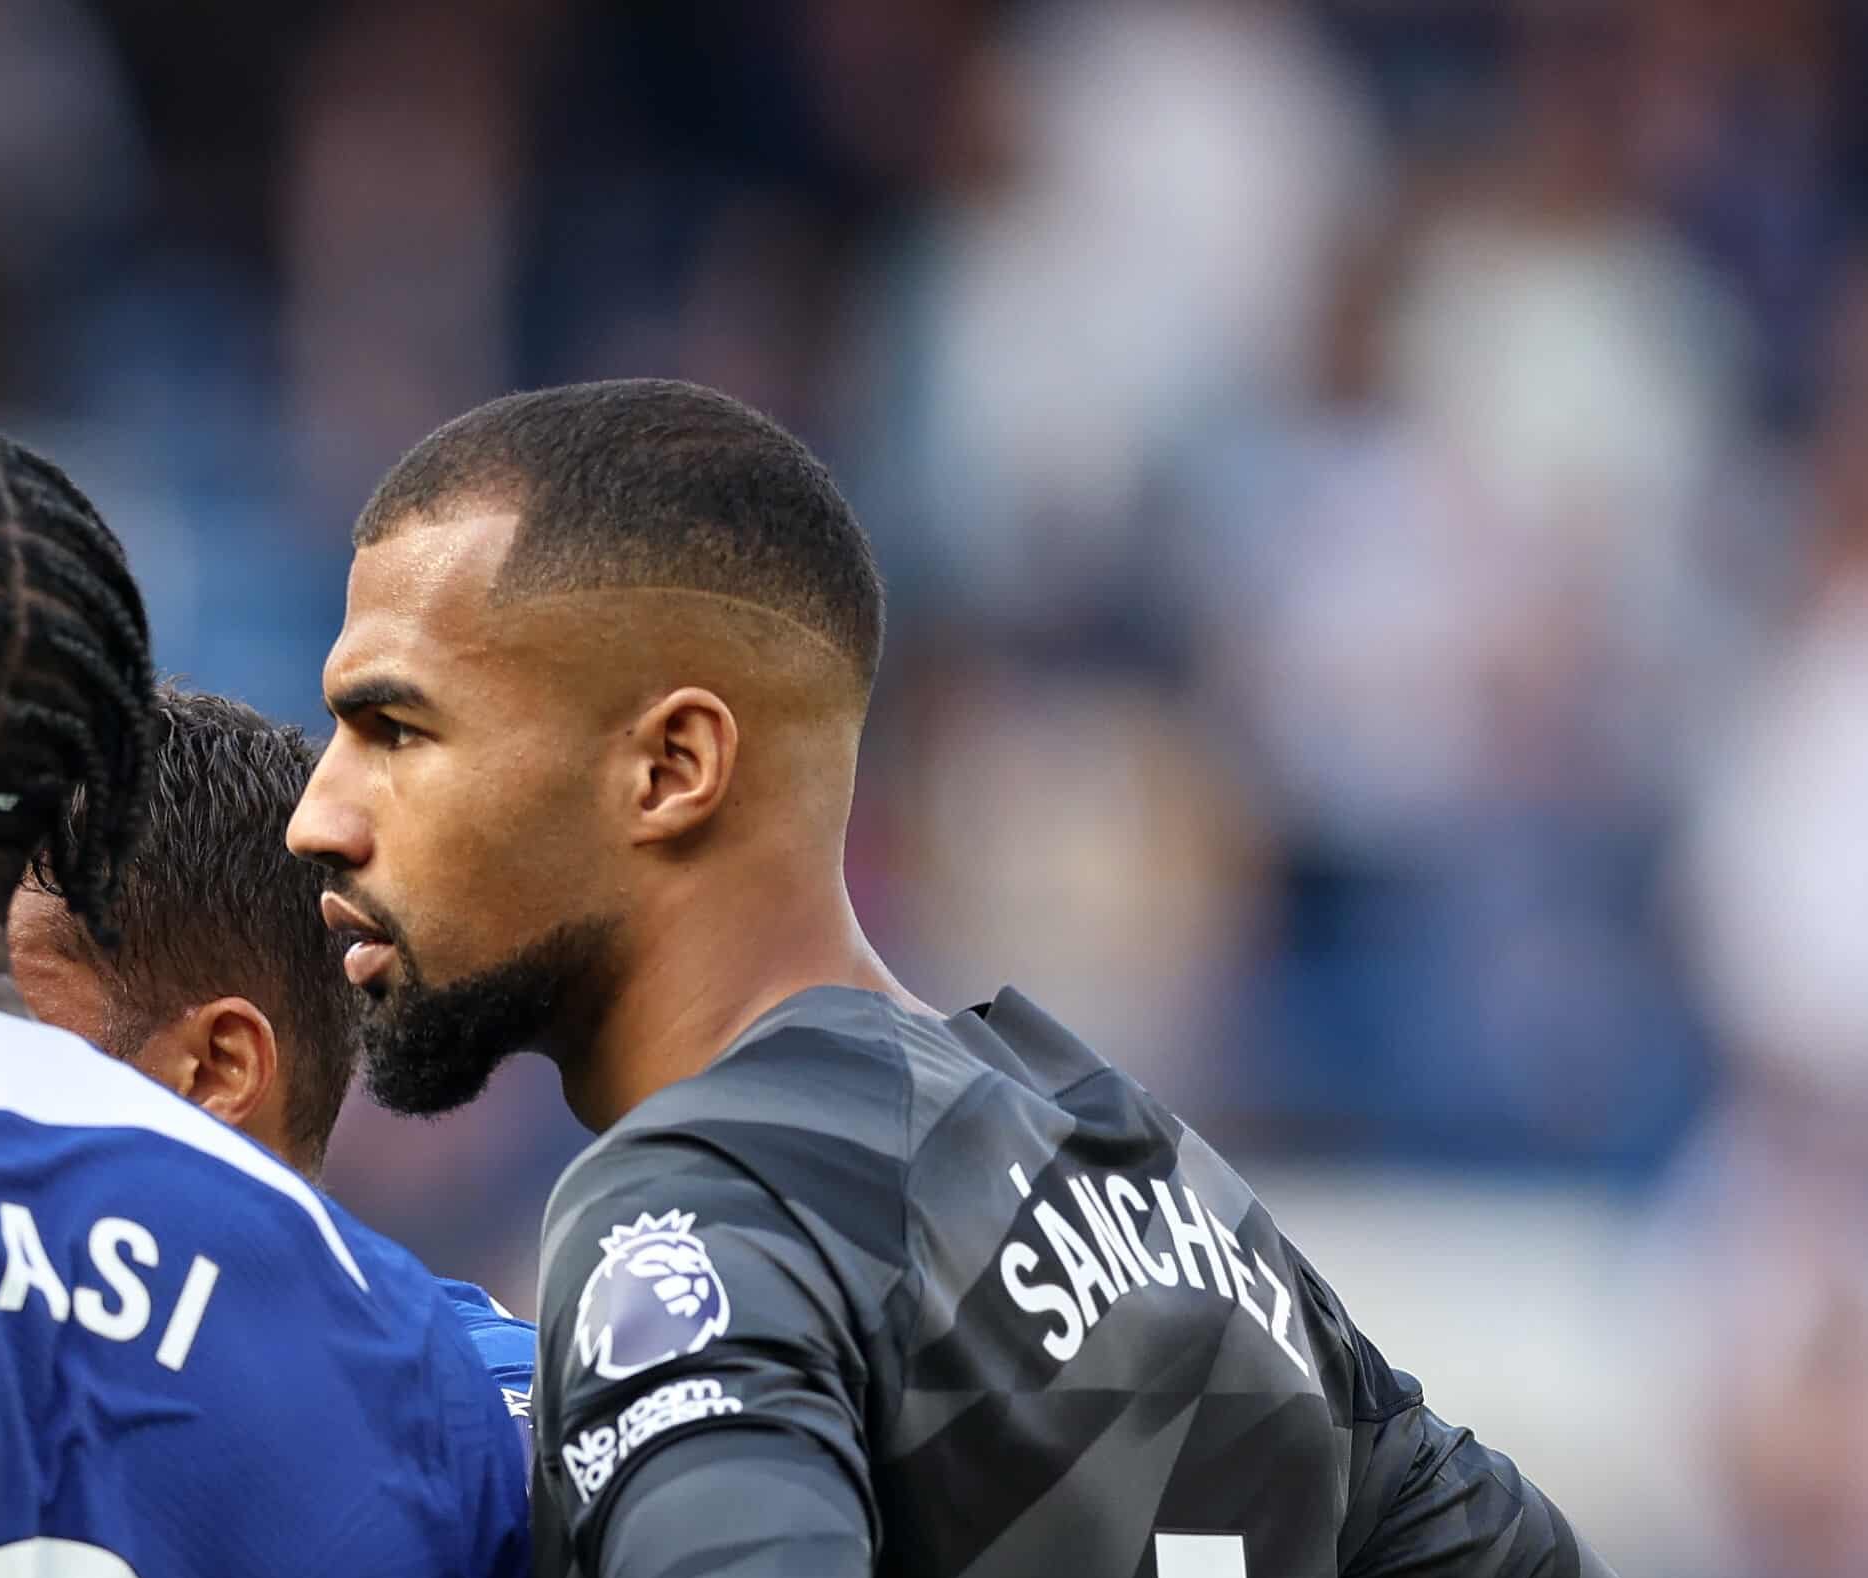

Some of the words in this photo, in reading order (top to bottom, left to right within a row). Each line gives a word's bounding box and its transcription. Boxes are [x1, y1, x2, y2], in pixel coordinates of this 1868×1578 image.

[1000, 1162, 1309, 1377] SÁNCHEZ
[562, 1426, 617, 1473] No
[617, 1379, 722, 1437] room
